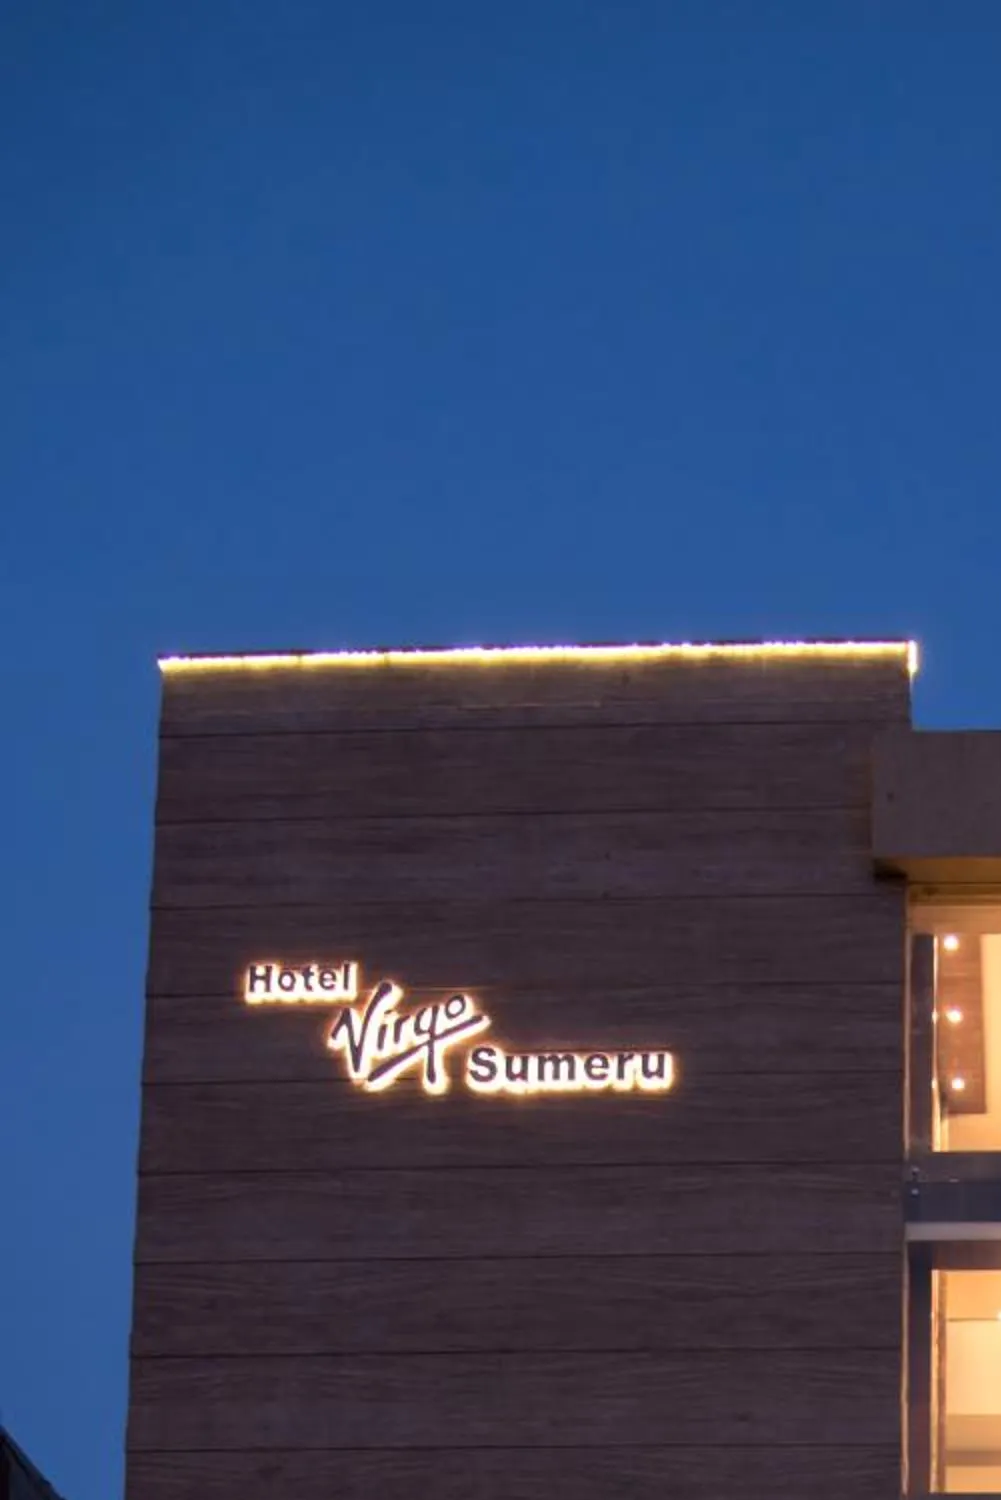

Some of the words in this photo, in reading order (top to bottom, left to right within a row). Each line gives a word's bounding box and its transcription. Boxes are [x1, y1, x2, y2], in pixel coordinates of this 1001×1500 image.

[246, 962, 355, 998] Hotel
[330, 980, 487, 1087] Virgo
[468, 1047, 669, 1085] Sumeru
